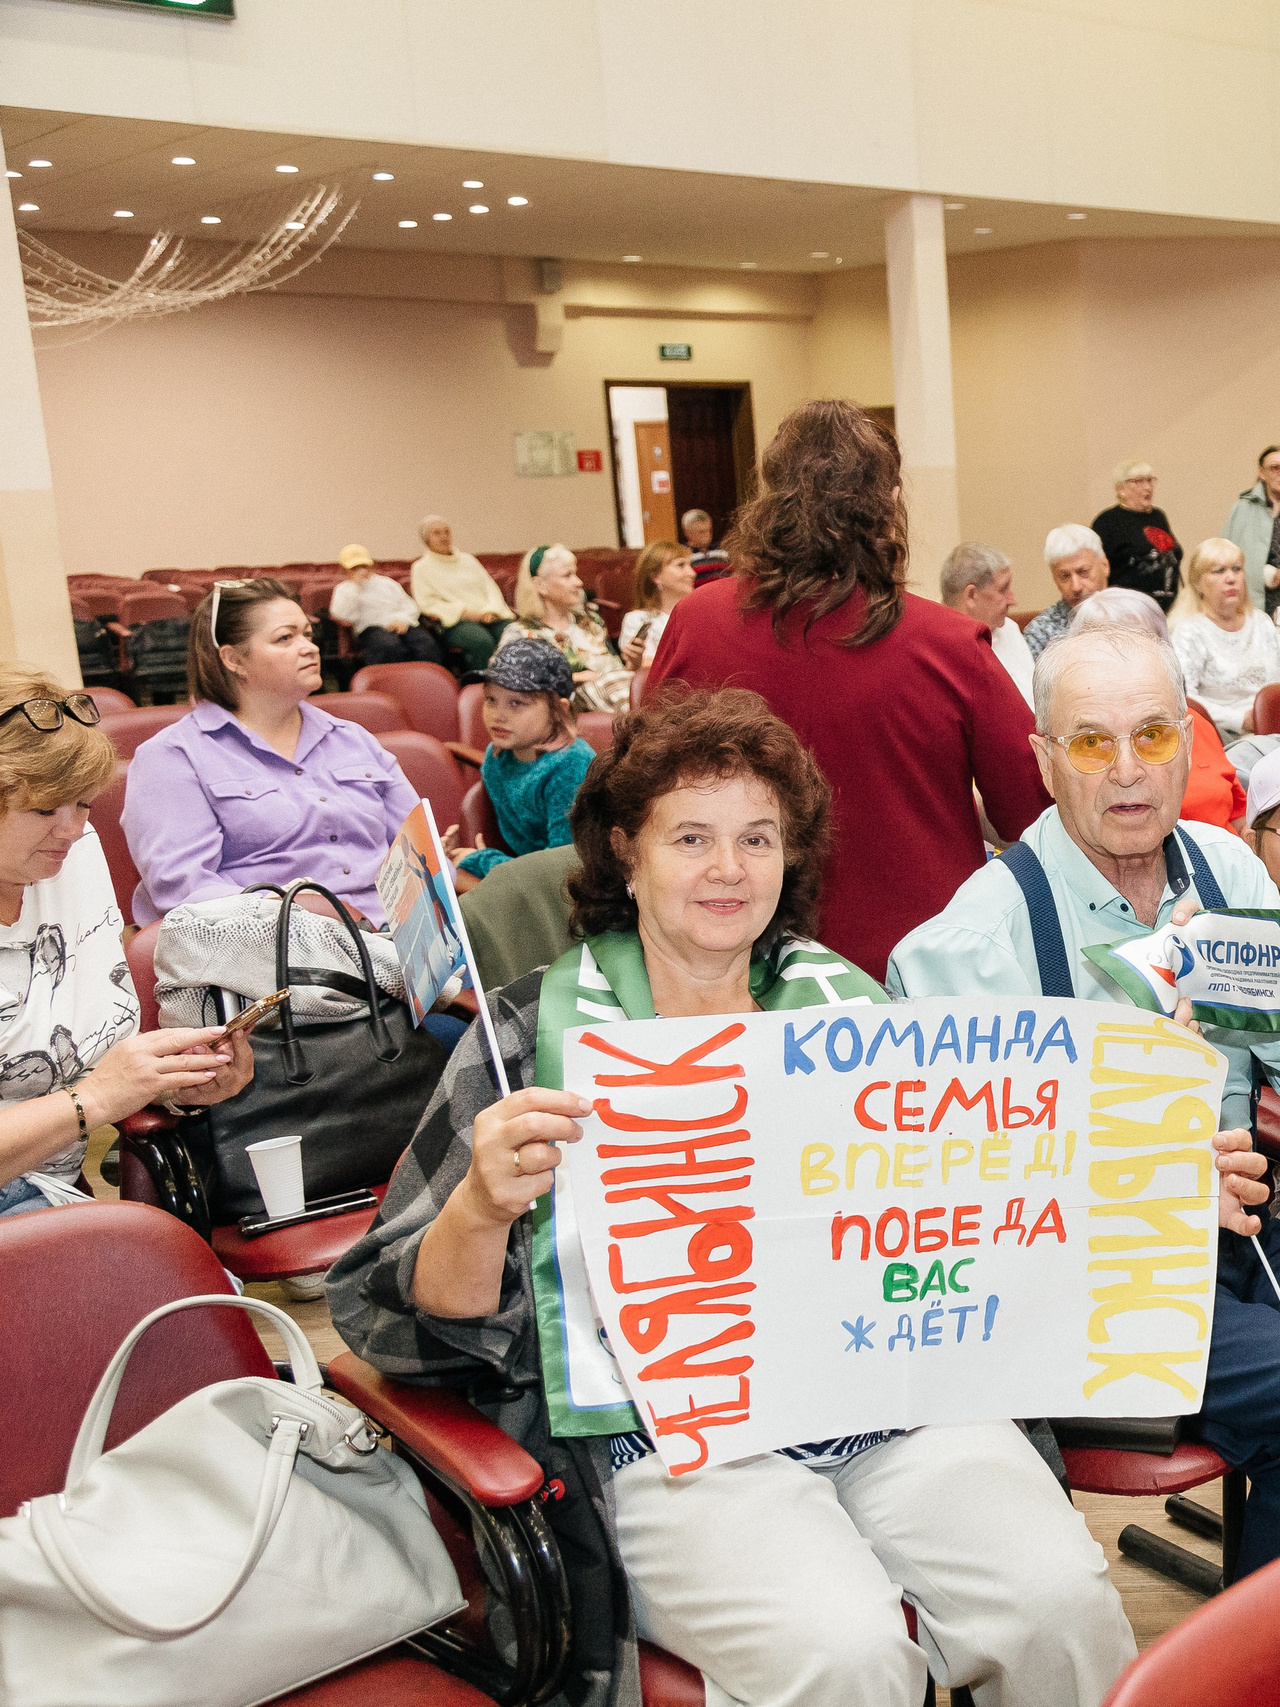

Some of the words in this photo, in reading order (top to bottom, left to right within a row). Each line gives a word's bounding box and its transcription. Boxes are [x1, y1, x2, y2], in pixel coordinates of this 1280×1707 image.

[1208, 983, 1231, 992] ППО
[783, 1009, 1077, 1076] КОМАНДА
[854, 1076, 1060, 1134] СЕМЬЯ
[800, 1130, 1077, 1197] ВПЕРЁД!
[831, 1197, 1067, 1261] ПОБЕДА
[1082, 1015, 1219, 1403] ЧЕЛЯБИНСК
[578, 1022, 758, 1477] ЧЕЛЯБИНСК
[882, 1257, 978, 1303] ВАС
